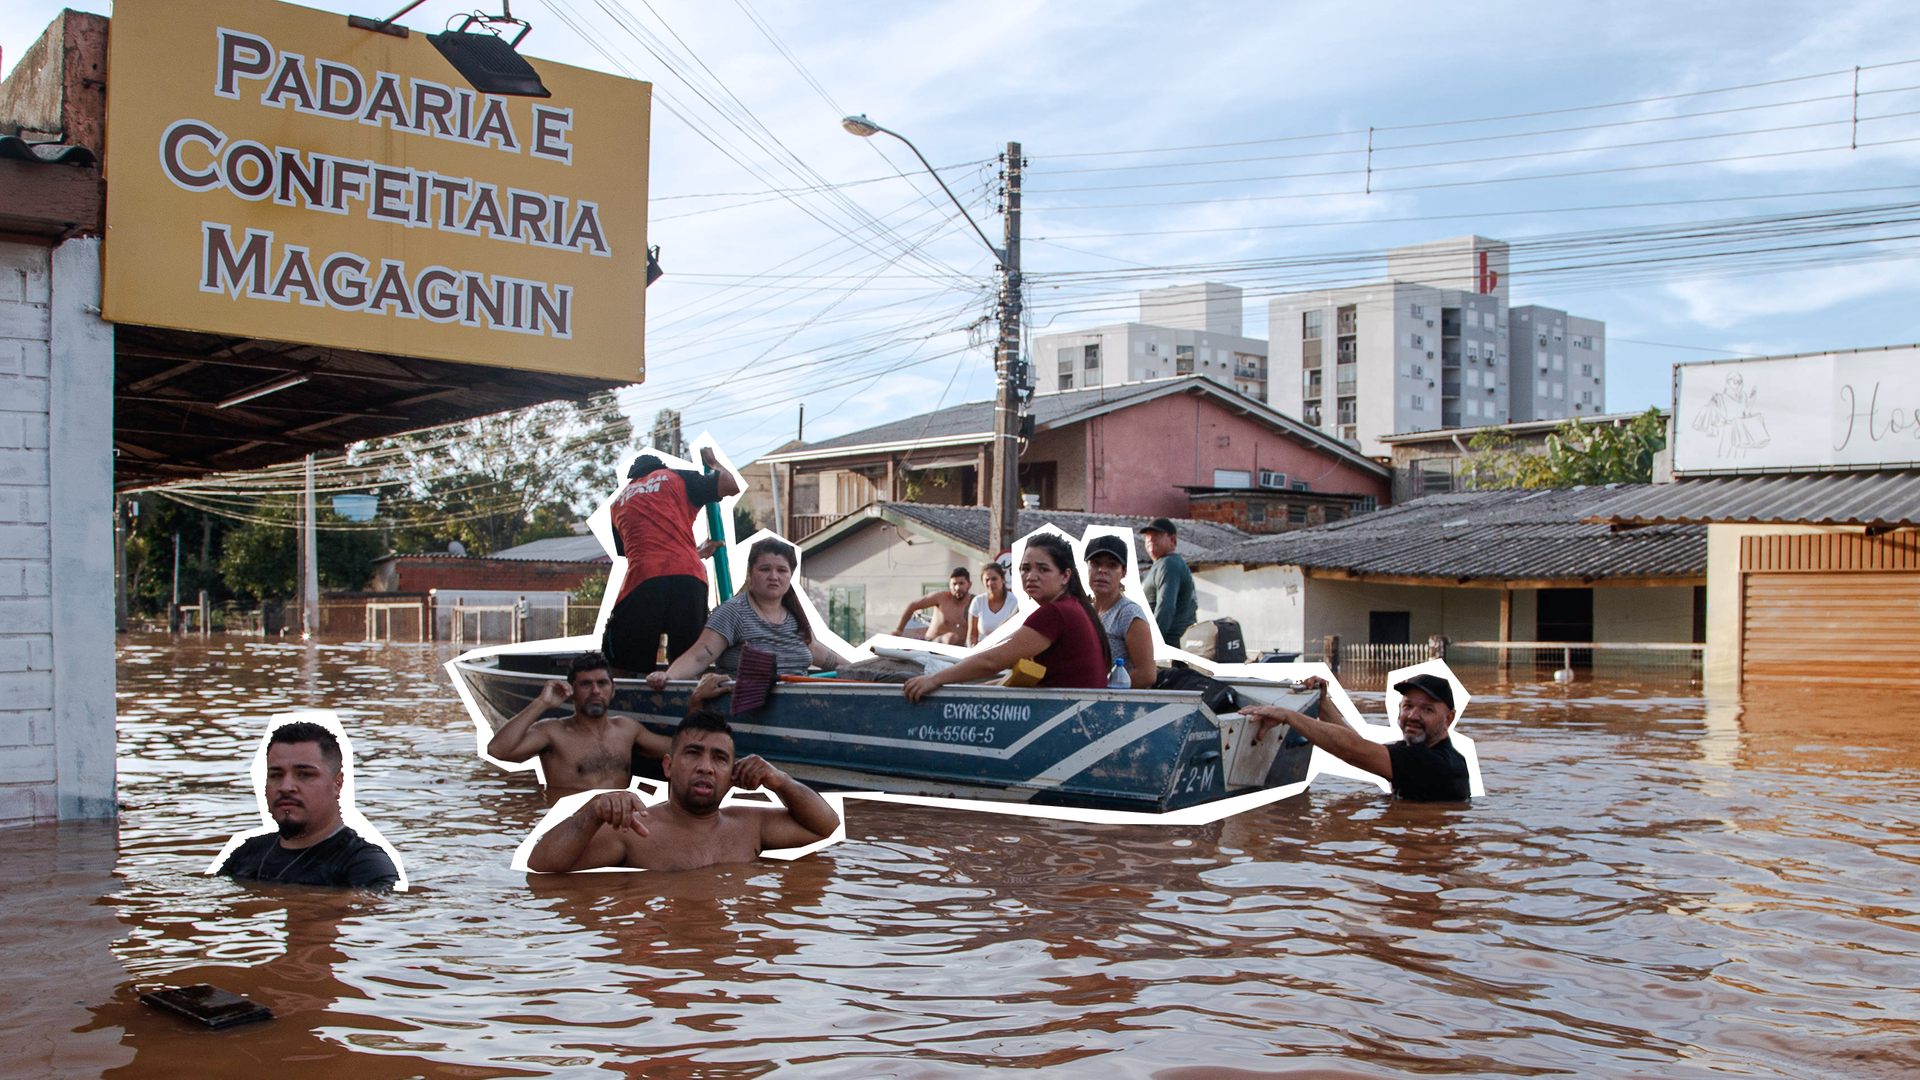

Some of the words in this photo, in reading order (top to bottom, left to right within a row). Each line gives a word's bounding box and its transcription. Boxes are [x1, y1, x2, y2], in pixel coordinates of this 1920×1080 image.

[215, 27, 520, 153] PADARIA
[531, 103, 573, 165] E
[160, 119, 611, 257] CONFEITARIA
[200, 221, 573, 338] MAGAGNIN
[1227, 641, 1240, 651] 15
[943, 703, 1031, 721] EXPRESSINHO
